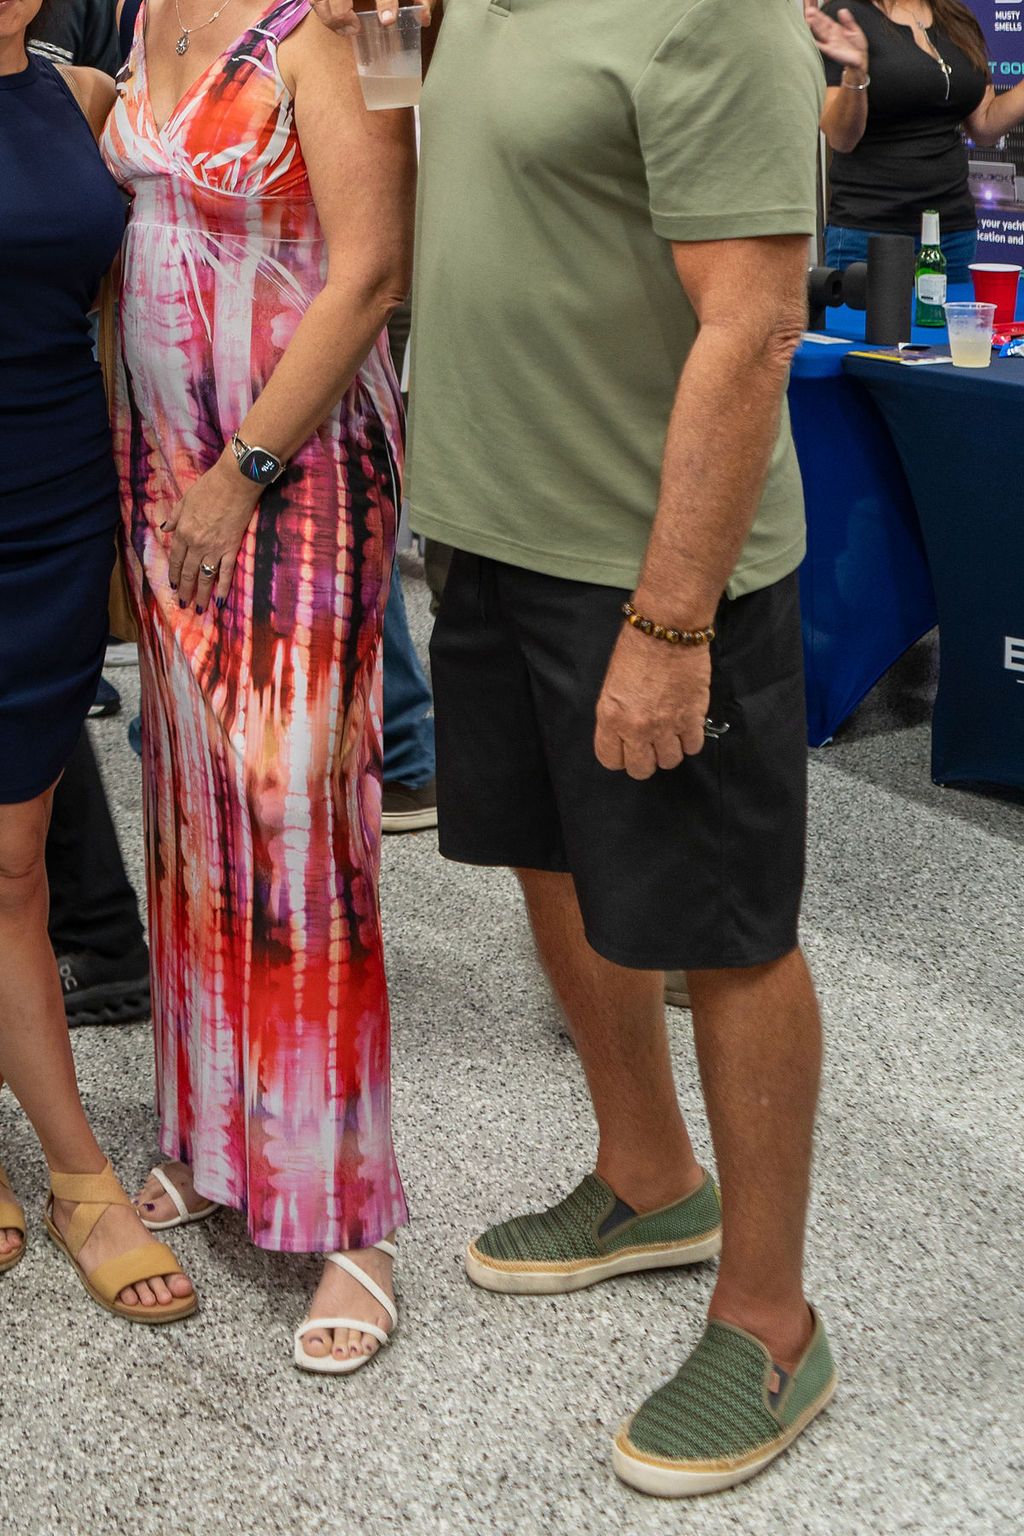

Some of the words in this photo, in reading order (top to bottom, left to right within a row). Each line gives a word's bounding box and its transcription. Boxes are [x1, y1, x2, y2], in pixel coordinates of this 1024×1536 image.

[995, 11, 1020, 21] MUSTY
[994, 21, 1023, 32] SMELLS
[981, 218, 1000, 229] your
